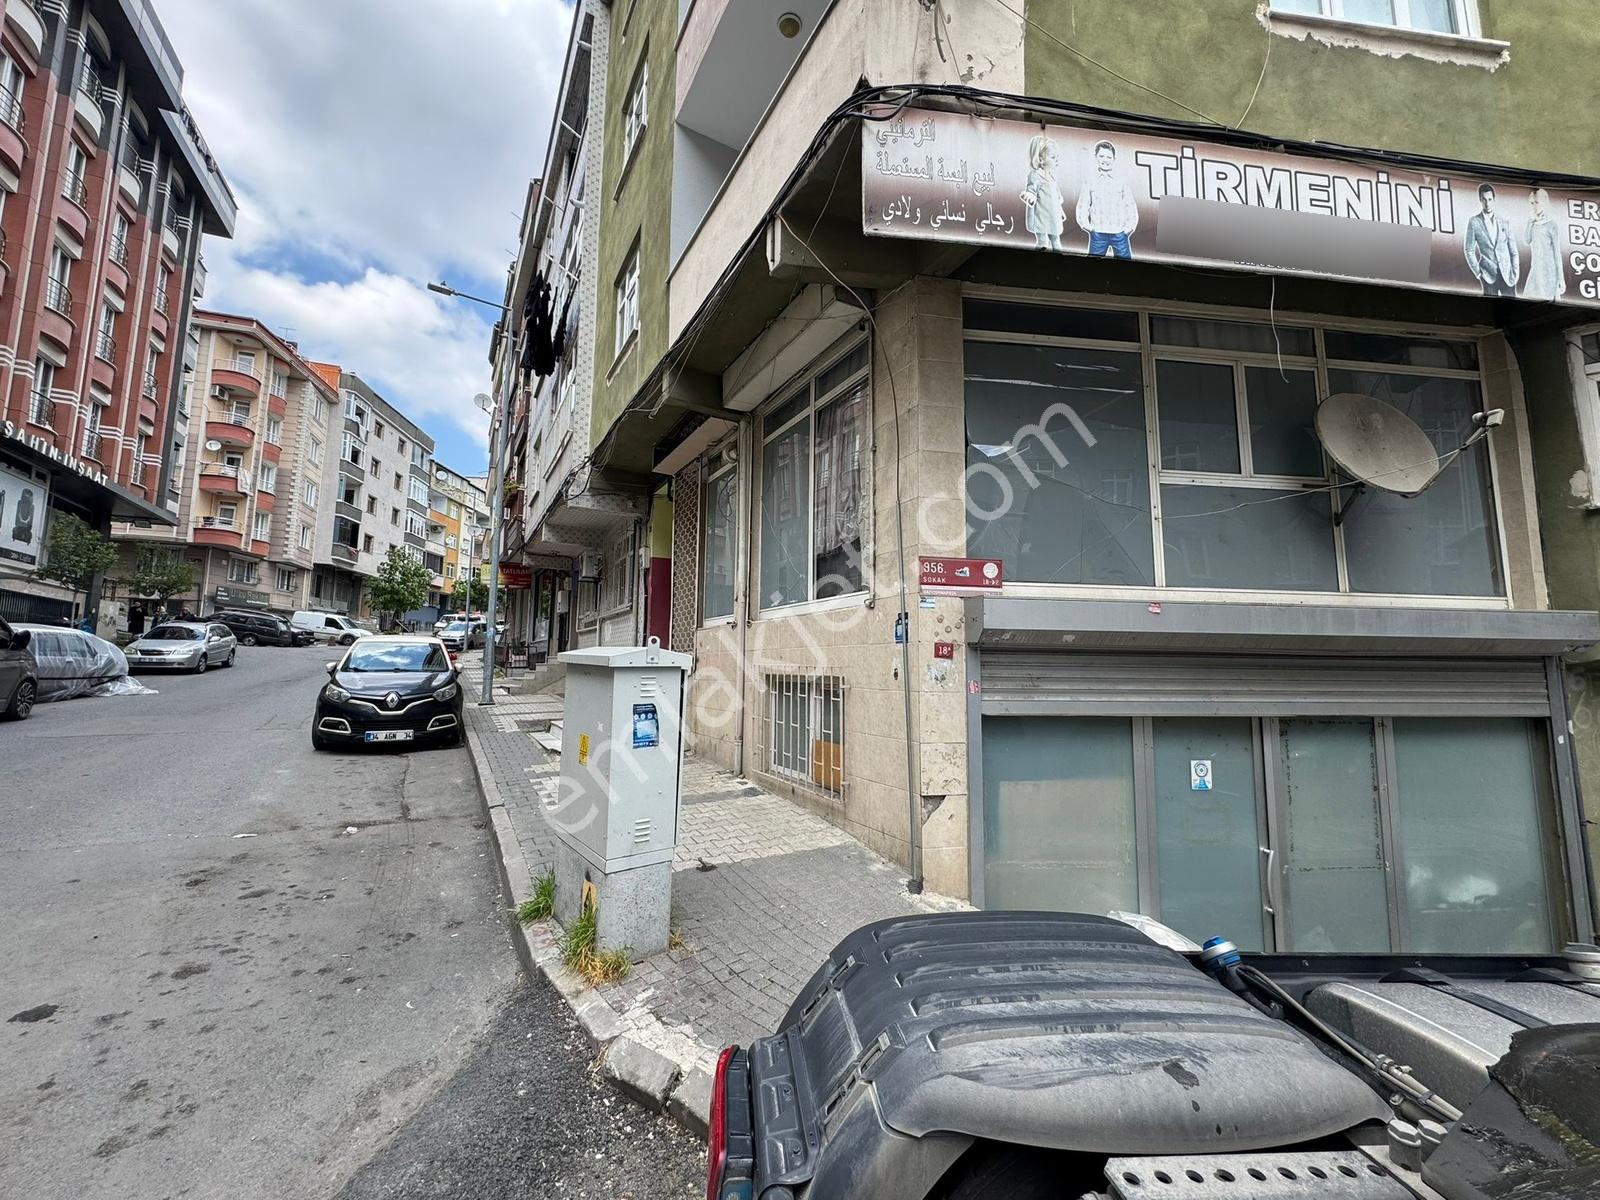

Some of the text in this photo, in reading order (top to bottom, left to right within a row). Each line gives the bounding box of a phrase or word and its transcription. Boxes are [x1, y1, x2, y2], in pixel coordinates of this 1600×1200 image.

[1135, 146, 1455, 234] TİRMENİNİ
[975, 202, 1014, 235] رجالي
[1567, 198, 1600, 221] ER
